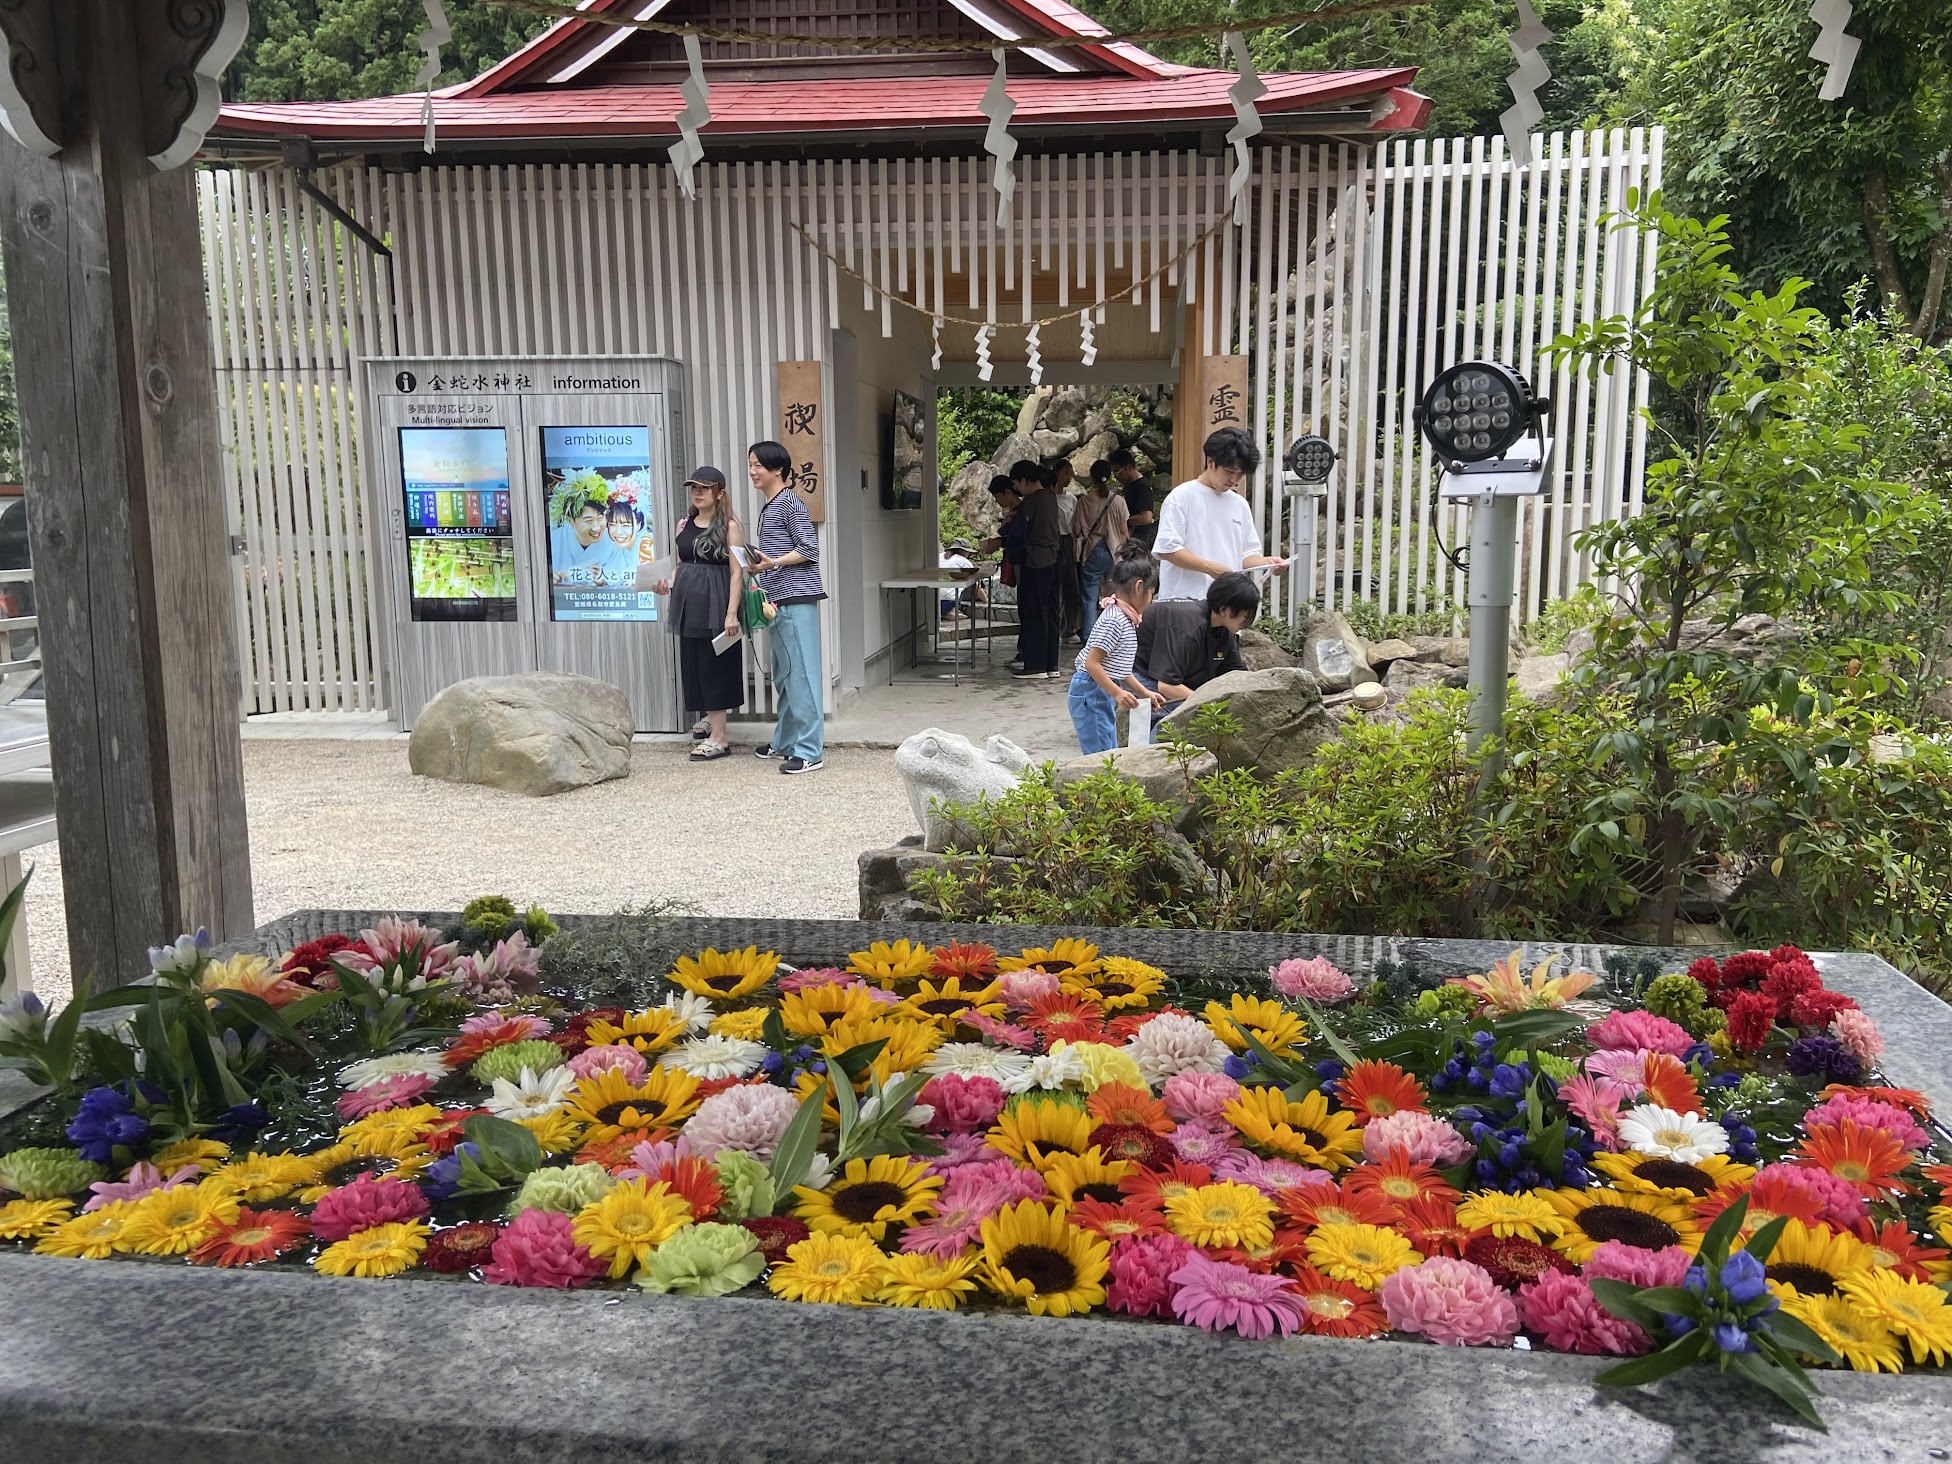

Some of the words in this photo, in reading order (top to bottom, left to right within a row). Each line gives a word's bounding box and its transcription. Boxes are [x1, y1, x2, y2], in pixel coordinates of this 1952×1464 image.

[428, 373, 532, 391] 金蛇水神社
[553, 375, 640, 389] information
[407, 404, 494, 414] 多言語対応ビジョン
[412, 416, 463, 425] Multi-lingual
[465, 416, 489, 424] vision
[564, 433, 633, 446] ambitious
[623, 571, 636, 580] ar
[564, 592, 636, 600] TEL:080-6018-5121
